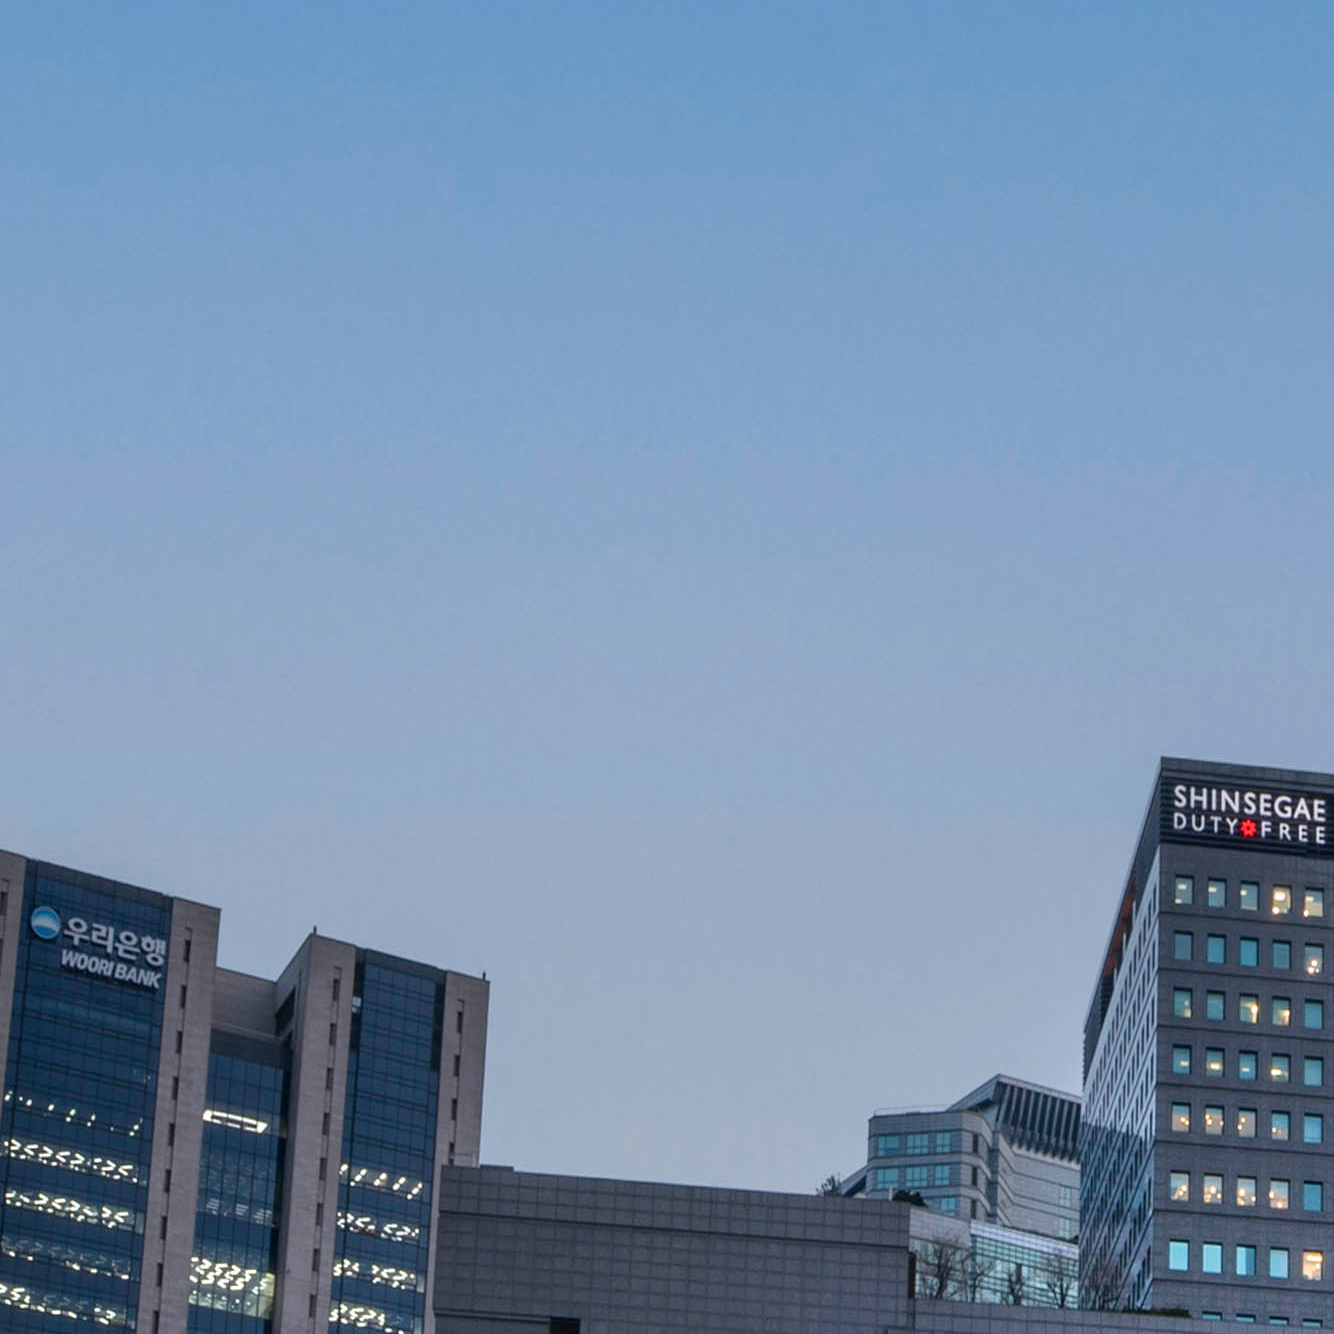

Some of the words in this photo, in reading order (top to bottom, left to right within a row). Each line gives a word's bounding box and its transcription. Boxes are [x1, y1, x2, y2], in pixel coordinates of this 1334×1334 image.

[1173, 784, 1326, 822] SHINSEGAE
[1173, 812, 1238, 835] DUTY
[1260, 820, 1326, 845] FREE
[63, 916, 166, 966] 우리은행
[61, 948, 115, 977] WOORI
[114, 963, 162, 988] BANK
